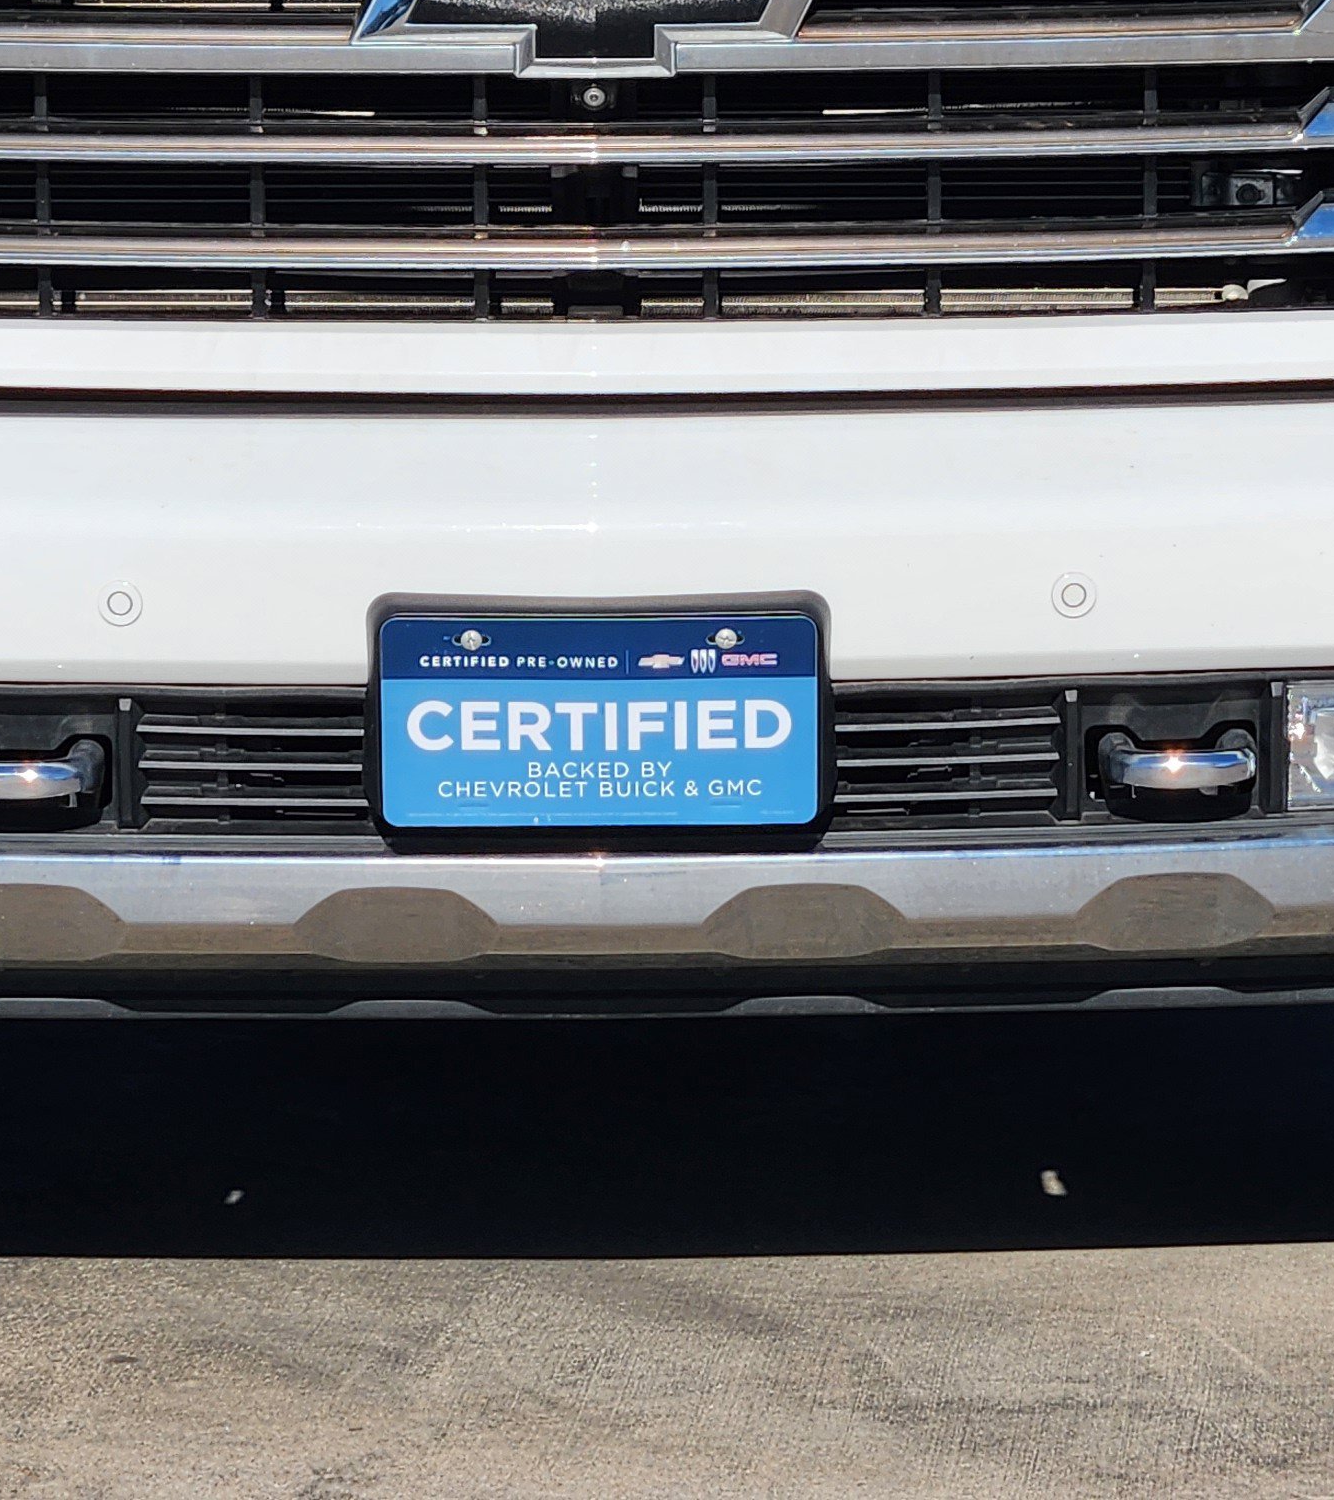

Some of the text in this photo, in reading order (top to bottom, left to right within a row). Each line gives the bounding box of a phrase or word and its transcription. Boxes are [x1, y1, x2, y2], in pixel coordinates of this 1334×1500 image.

[419, 654, 619, 669] CERTIFIED PRE-OWNED
[720, 652, 779, 667] GMC
[406, 698, 793, 752] CERTIFIED
[527, 760, 673, 779] BACKED BY
[437, 779, 763, 799] CHEVROLET BUICK & GMC
